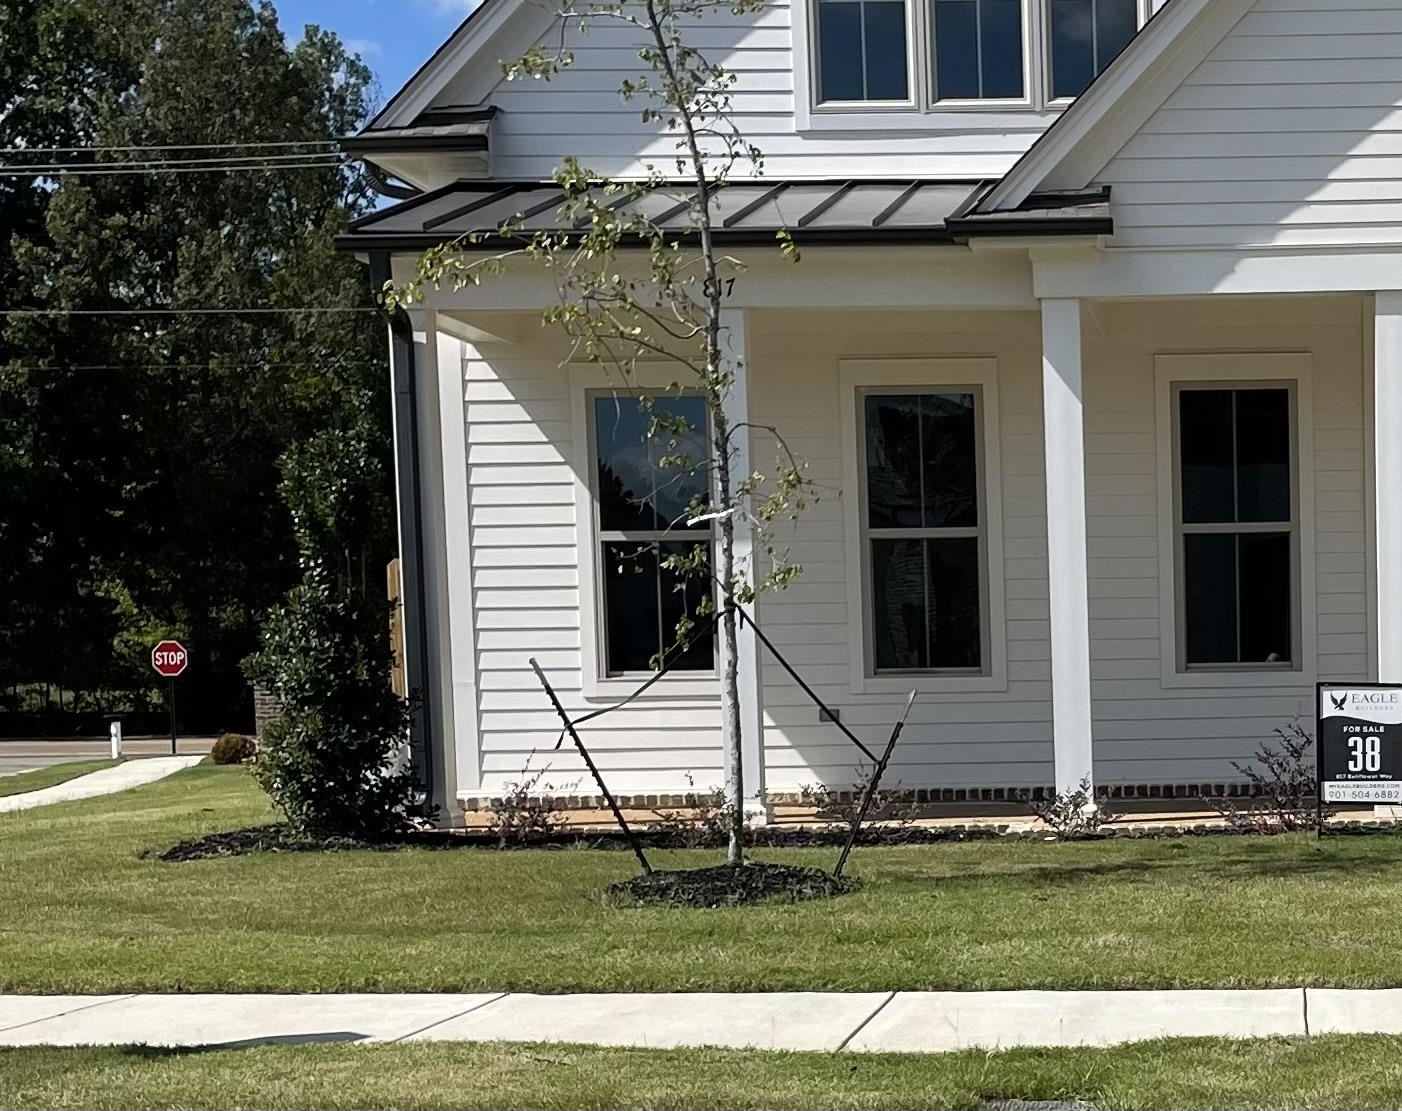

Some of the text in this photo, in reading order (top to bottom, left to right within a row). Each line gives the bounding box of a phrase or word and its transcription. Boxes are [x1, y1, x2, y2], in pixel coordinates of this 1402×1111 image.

[155, 651, 184, 665] STOP
[1351, 693, 1398, 703] EAGLE
[1347, 736, 1380, 772] 38
